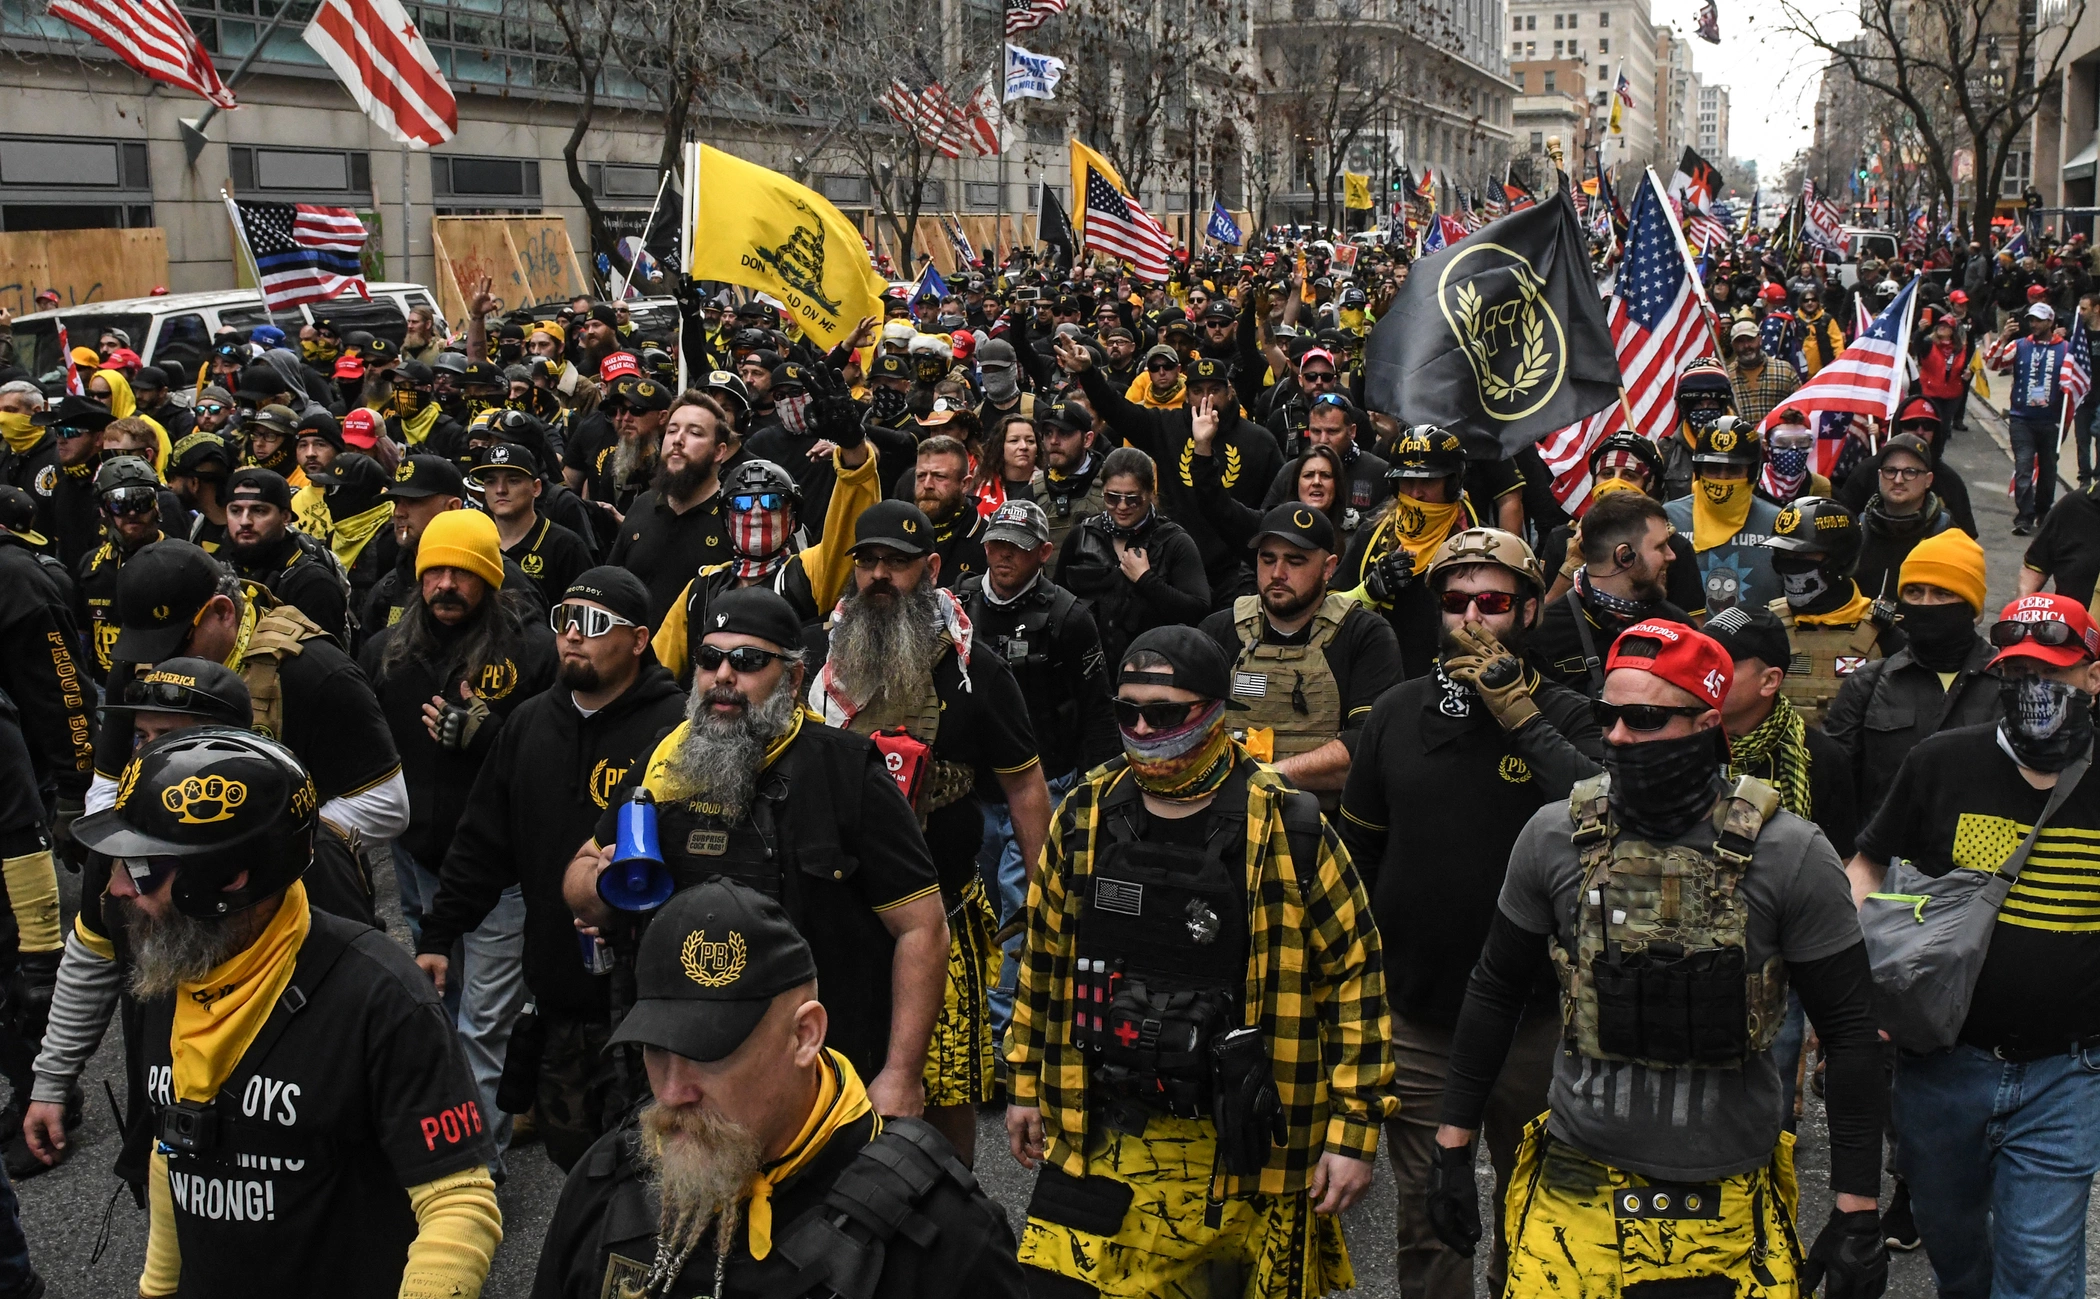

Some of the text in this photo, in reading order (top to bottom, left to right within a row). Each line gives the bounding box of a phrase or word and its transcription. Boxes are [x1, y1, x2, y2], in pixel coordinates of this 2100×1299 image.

[802, 305, 837, 334] ON ME
[2045, 350, 2055, 372] MAKE
[1716, 433, 1730, 446] PB
[1001, 506, 1028, 518] Trump
[1780, 512, 1791, 525] PB
[2017, 596, 2054, 610] KEEP
[1703, 669, 1726, 699] 45
[47, 631, 93, 772] PROUD BOYS
[689, 801, 721, 815] PROUD
[692, 834, 726, 844] SURPRISE
[700, 942, 729, 970] PB
[242, 1074, 301, 1127] OYS
[168, 1168, 276, 1222] WRONG!
